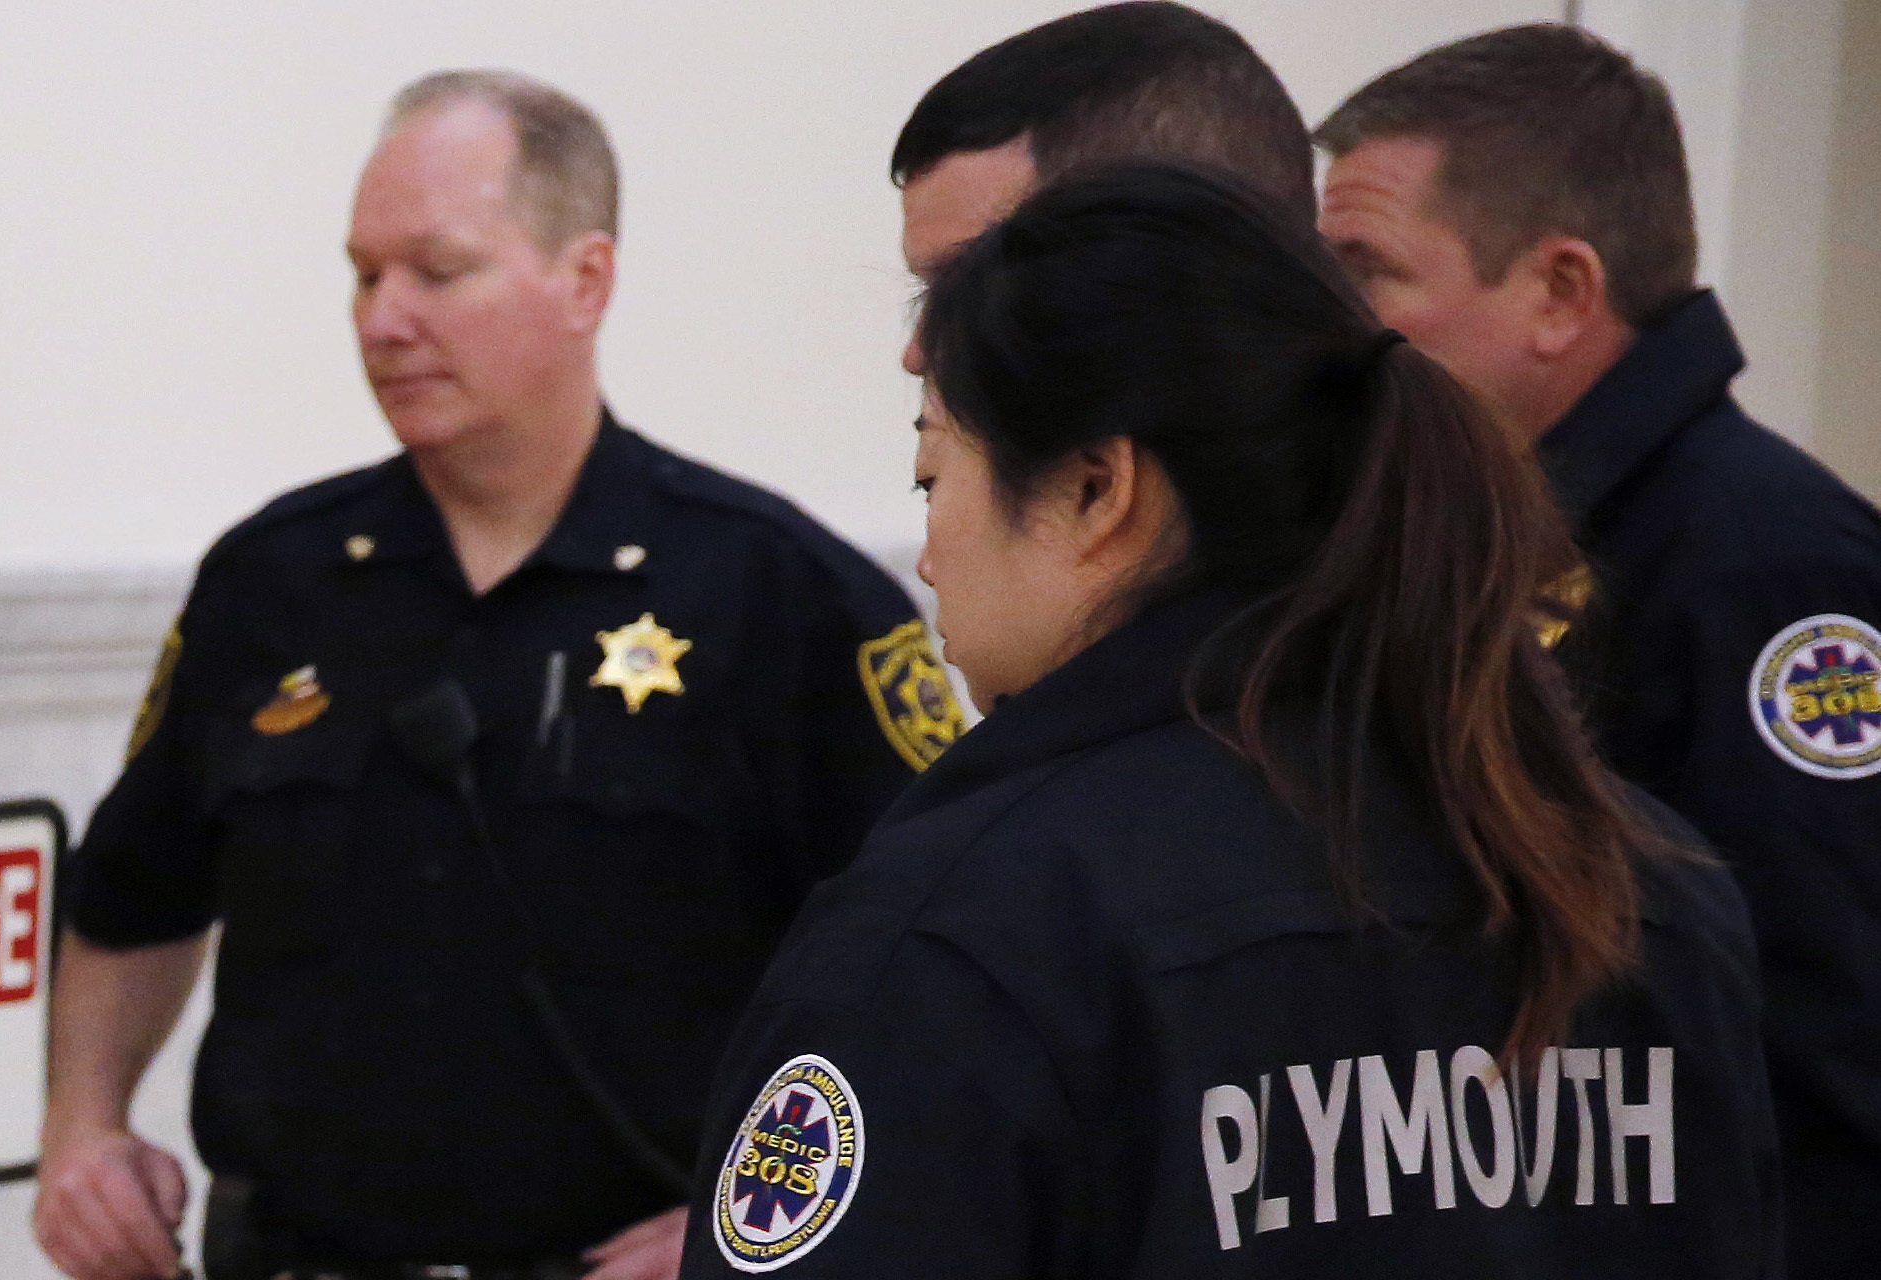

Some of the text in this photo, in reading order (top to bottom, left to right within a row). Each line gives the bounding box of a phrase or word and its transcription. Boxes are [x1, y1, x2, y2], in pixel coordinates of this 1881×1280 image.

[807, 1067, 855, 1168] AMBULANCE
[751, 1128, 827, 1161] MEDIC
[737, 1146, 819, 1195] 308
